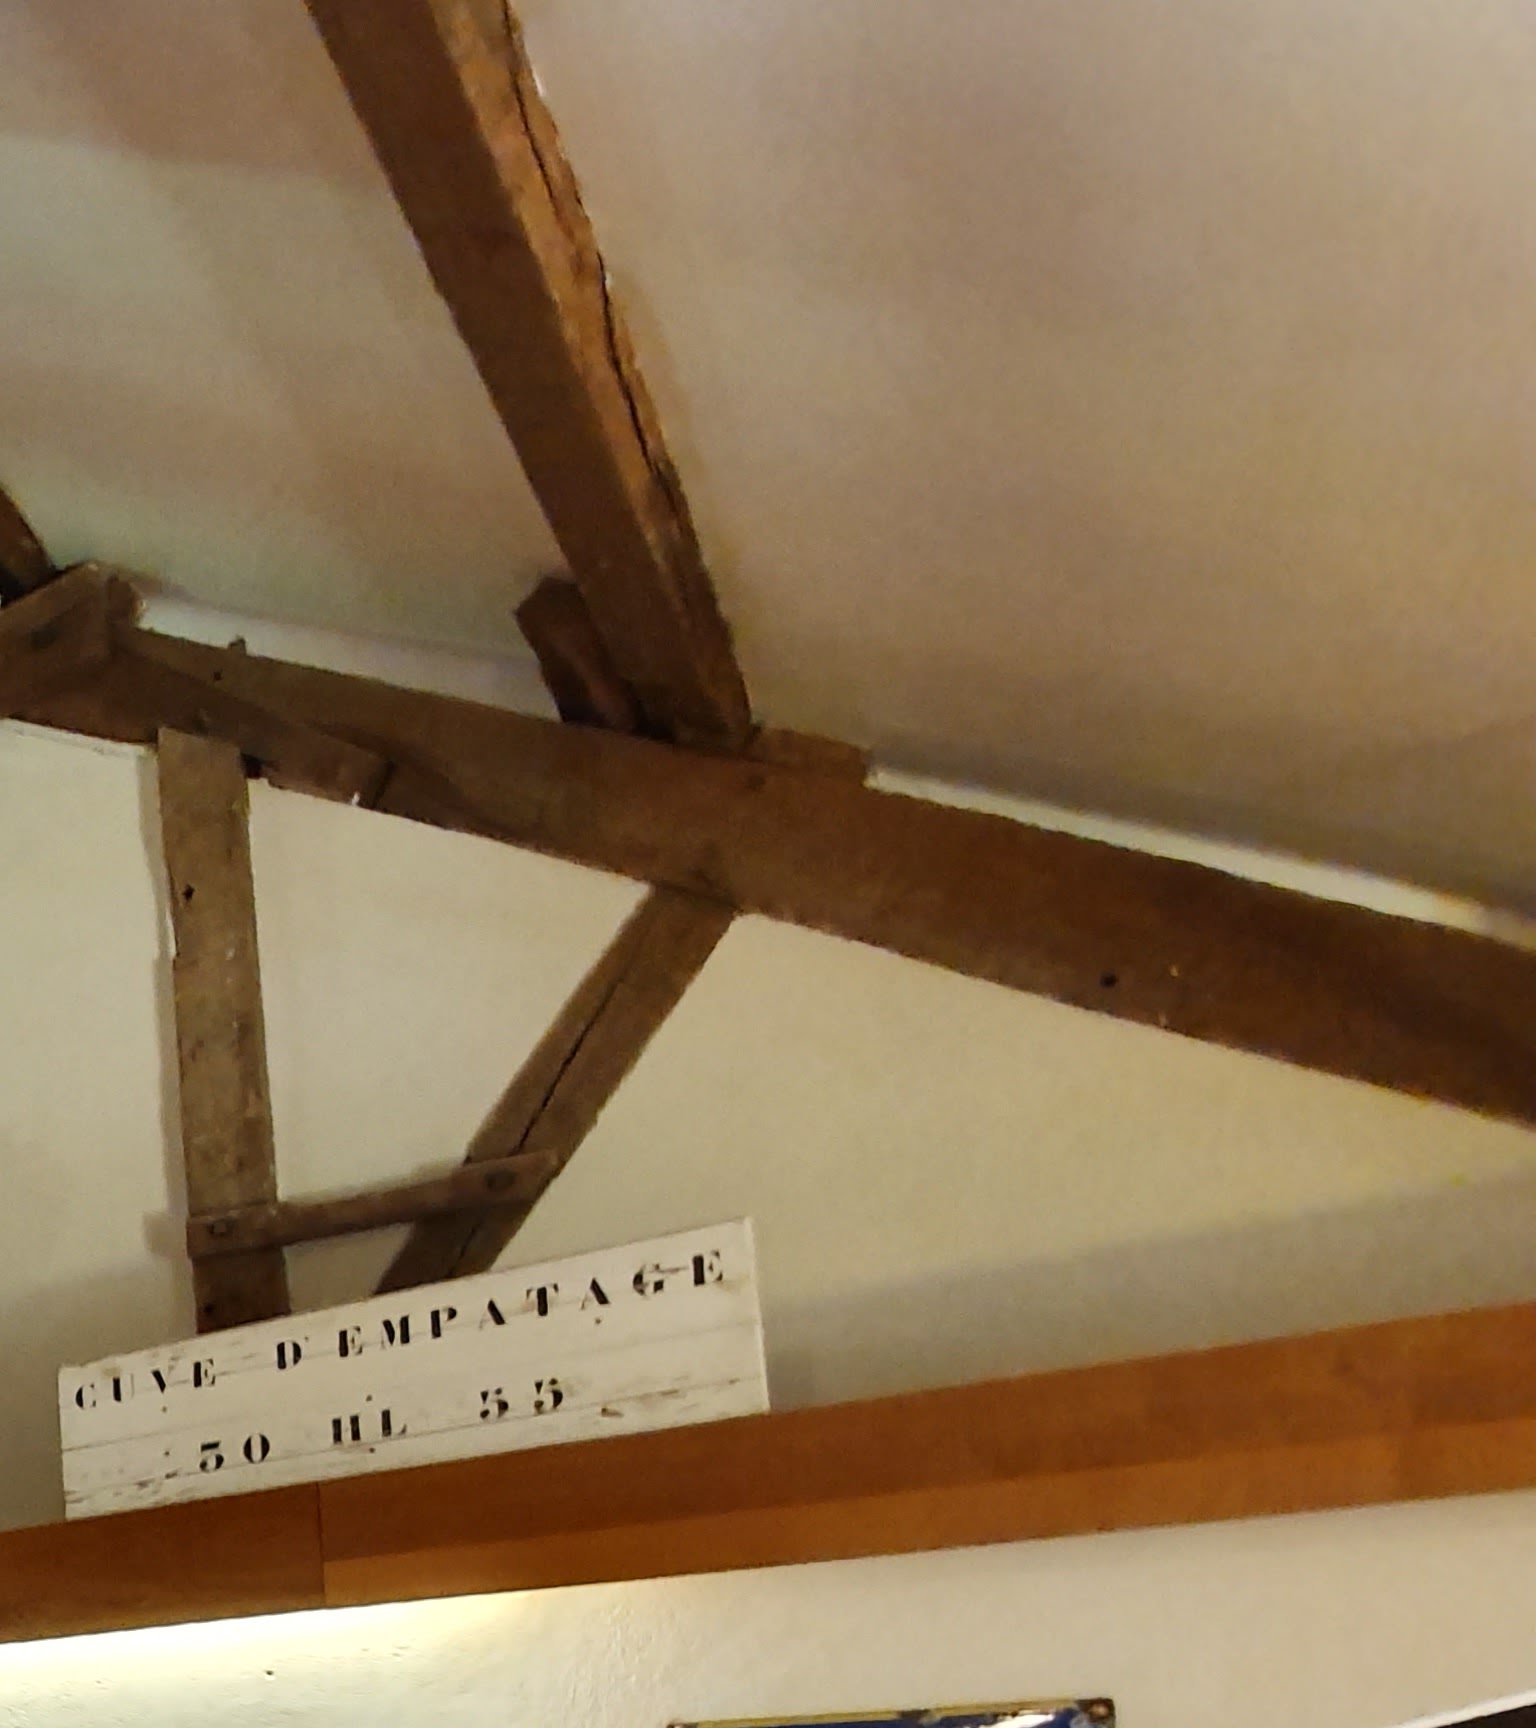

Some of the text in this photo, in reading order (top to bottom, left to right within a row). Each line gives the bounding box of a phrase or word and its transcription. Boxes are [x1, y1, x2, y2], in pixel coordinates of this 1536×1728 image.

[75, 1355, 216, 1410] CUVE
[331, 1408, 408, 1446] HL
[479, 1377, 565, 1421] 55
